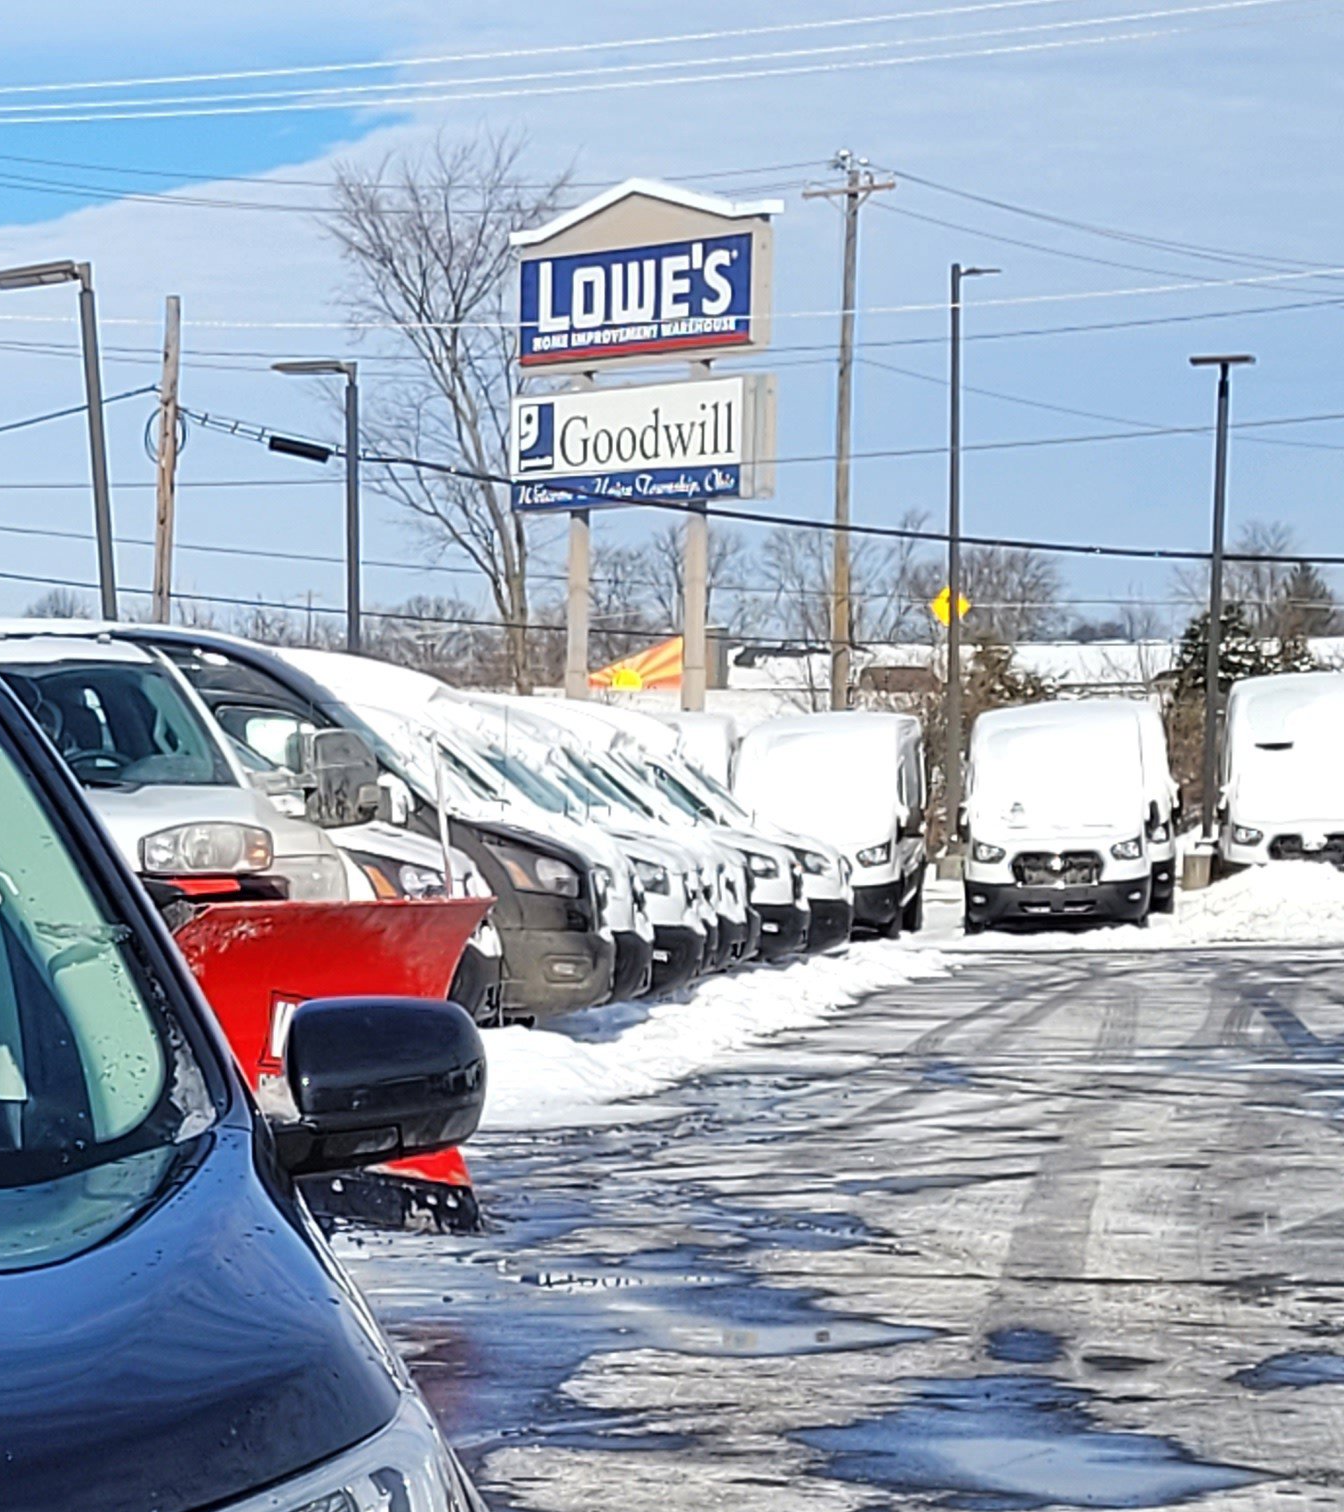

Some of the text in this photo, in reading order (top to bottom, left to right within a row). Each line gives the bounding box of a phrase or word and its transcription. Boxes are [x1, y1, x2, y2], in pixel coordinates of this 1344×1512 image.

[538, 243, 732, 333] LOWE'S
[532, 317, 736, 352] HOME IMPROVEMENT WAREHOUSE
[560, 401, 735, 467] Goodwill
